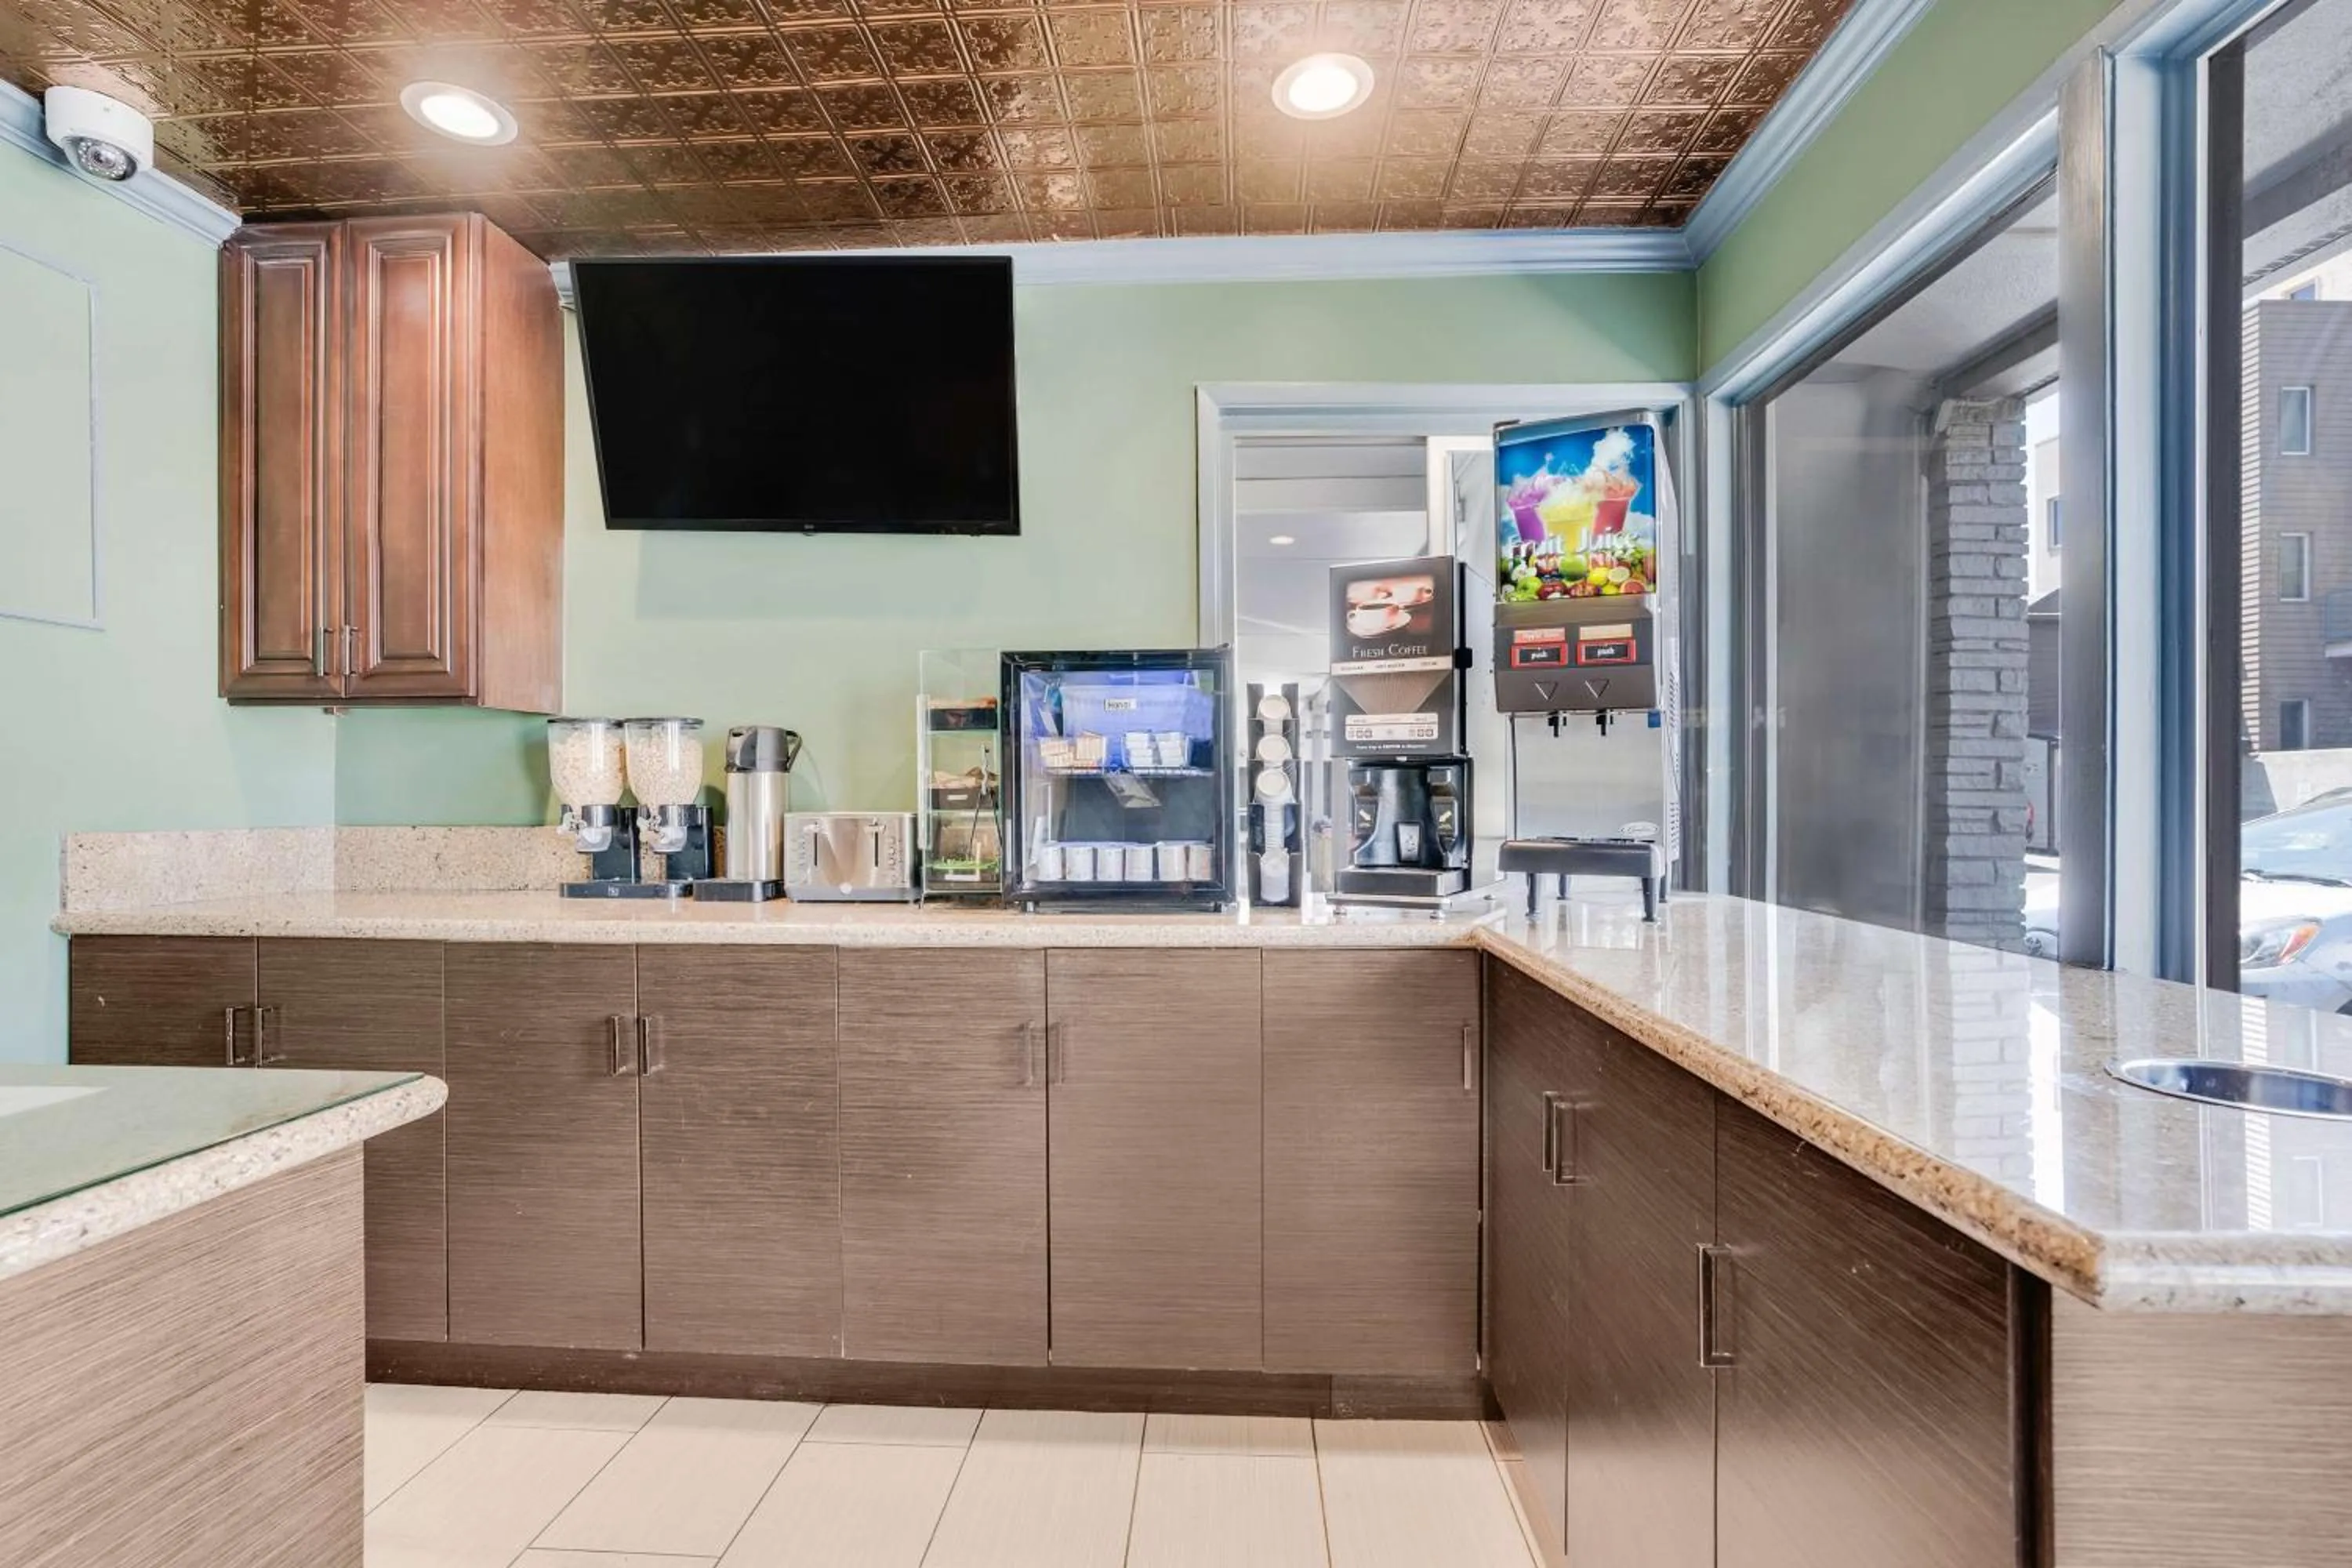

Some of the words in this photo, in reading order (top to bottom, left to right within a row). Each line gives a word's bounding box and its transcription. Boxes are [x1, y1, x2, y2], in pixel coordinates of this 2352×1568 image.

[1508, 532, 1564, 557] Fruit
[1576, 526, 1639, 552] Juice
[1388, 643, 1428, 656] COFFEE
